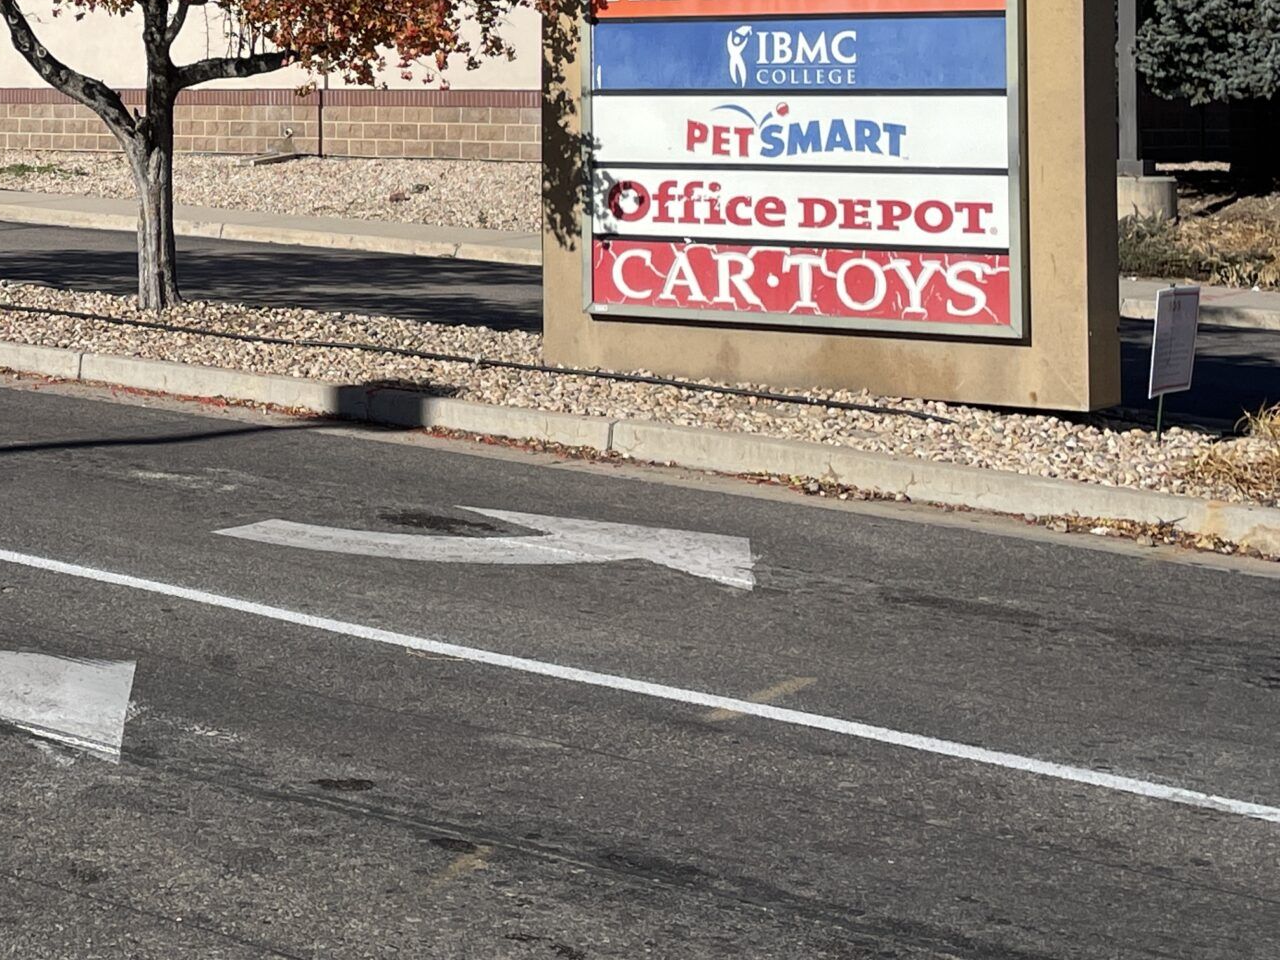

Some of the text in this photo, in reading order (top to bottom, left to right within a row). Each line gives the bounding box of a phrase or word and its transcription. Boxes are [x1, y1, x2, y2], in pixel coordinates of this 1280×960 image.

[756, 30, 857, 65] IBMC
[756, 68, 857, 85] COLLEGE
[608, 180, 994, 235] Office DEPOT
